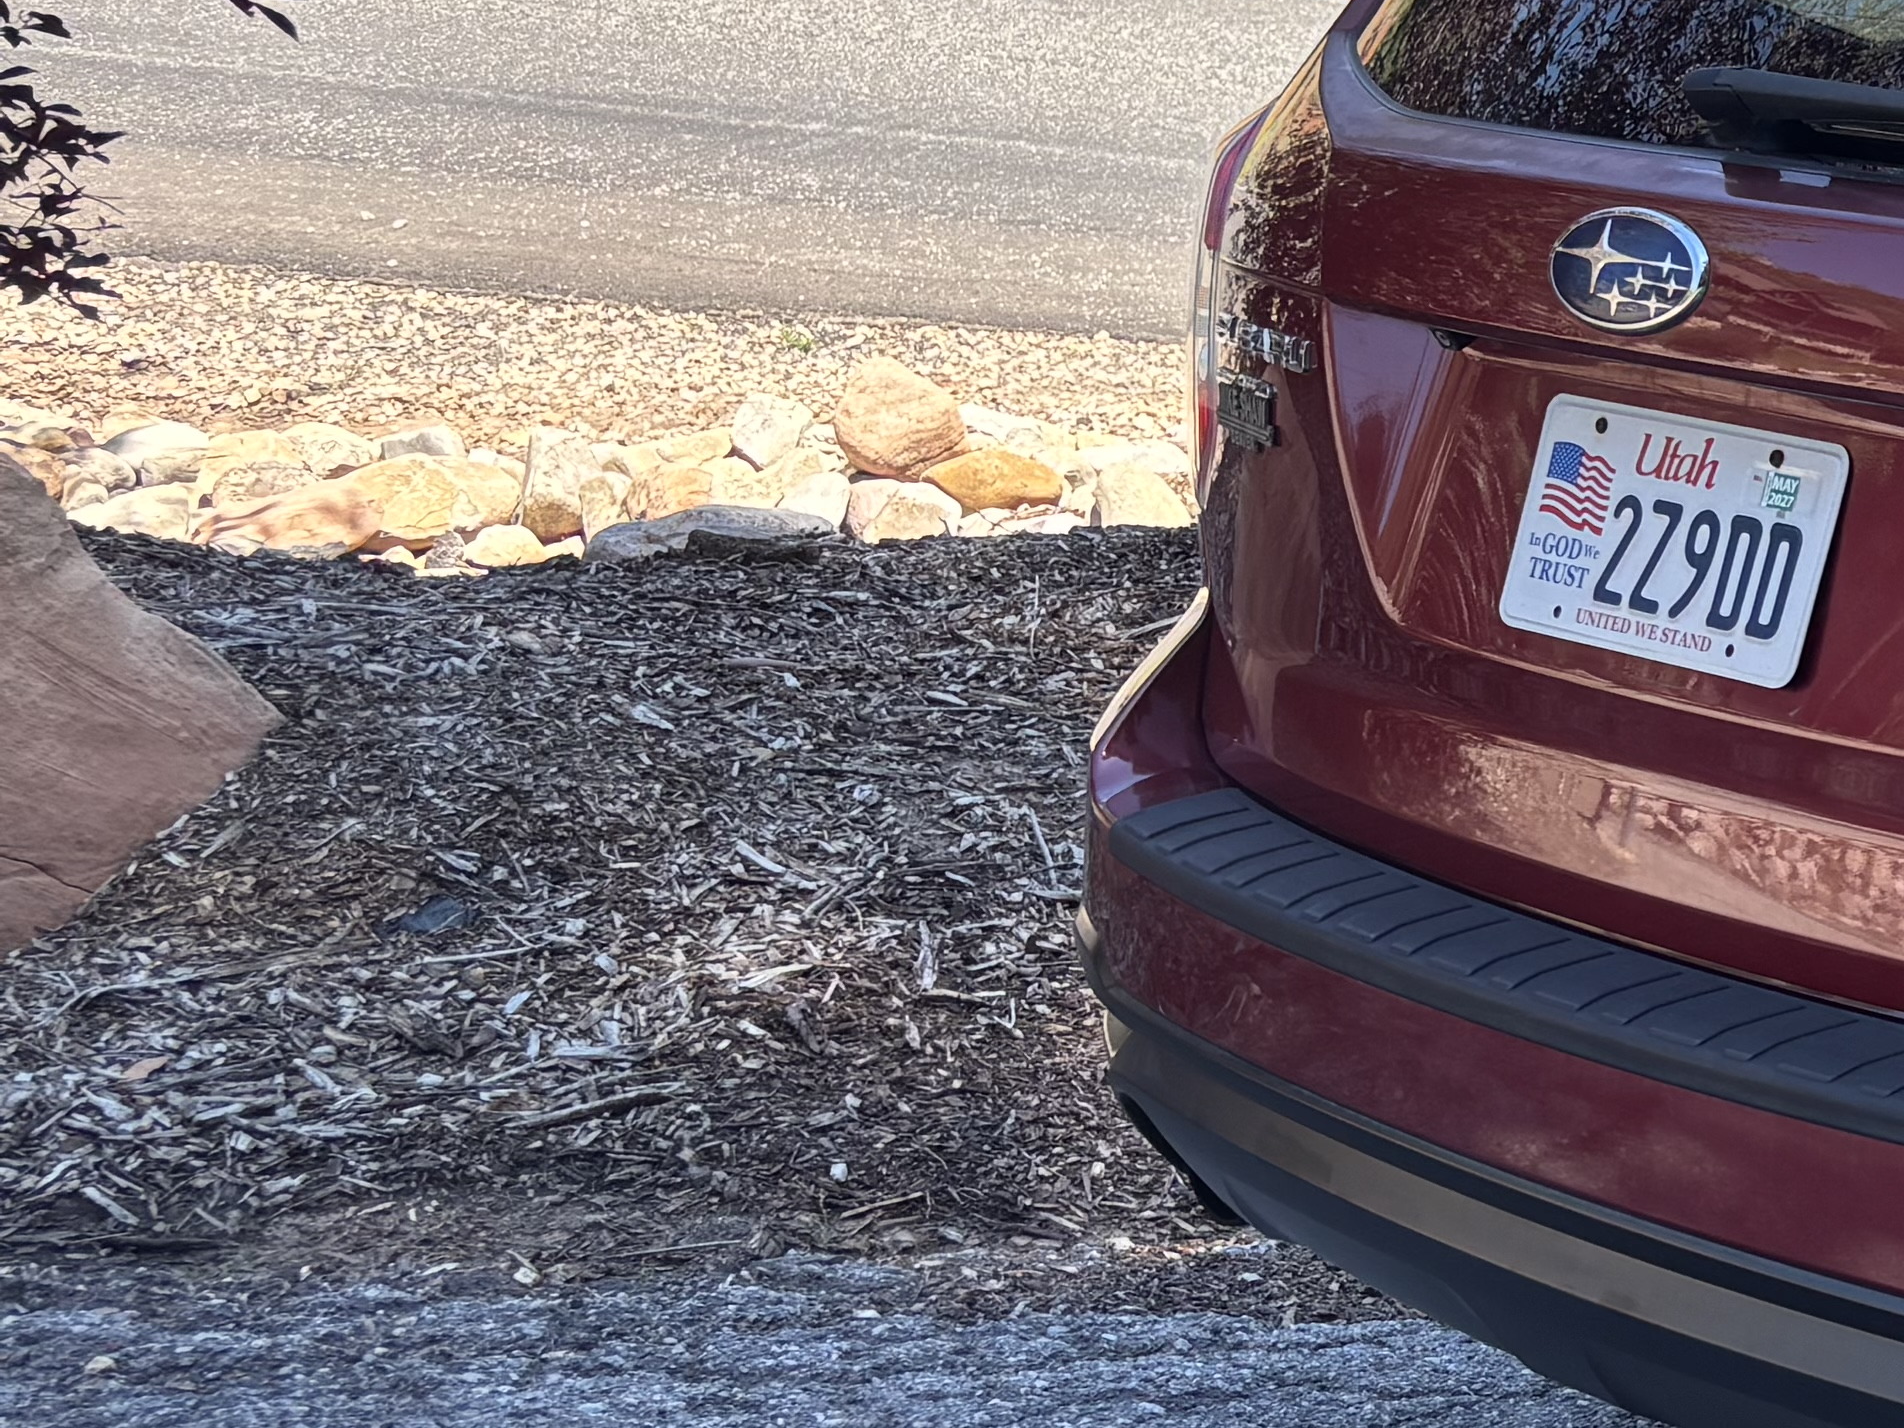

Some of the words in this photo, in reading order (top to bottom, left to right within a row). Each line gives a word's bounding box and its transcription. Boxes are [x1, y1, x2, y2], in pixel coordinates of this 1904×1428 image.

[1635, 433, 1720, 490] Utah
[1772, 475, 1800, 494] MAY
[1768, 492, 1795, 508] 2027
[1529, 532, 1541, 547] In
[1542, 532, 1583, 560] GOD
[1584, 544, 1601, 560] We
[1529, 556, 1590, 589] TRUST
[1575, 607, 1632, 634] UNITED
[1635, 620, 1660, 641] WE
[1660, 627, 1712, 653] STAND
